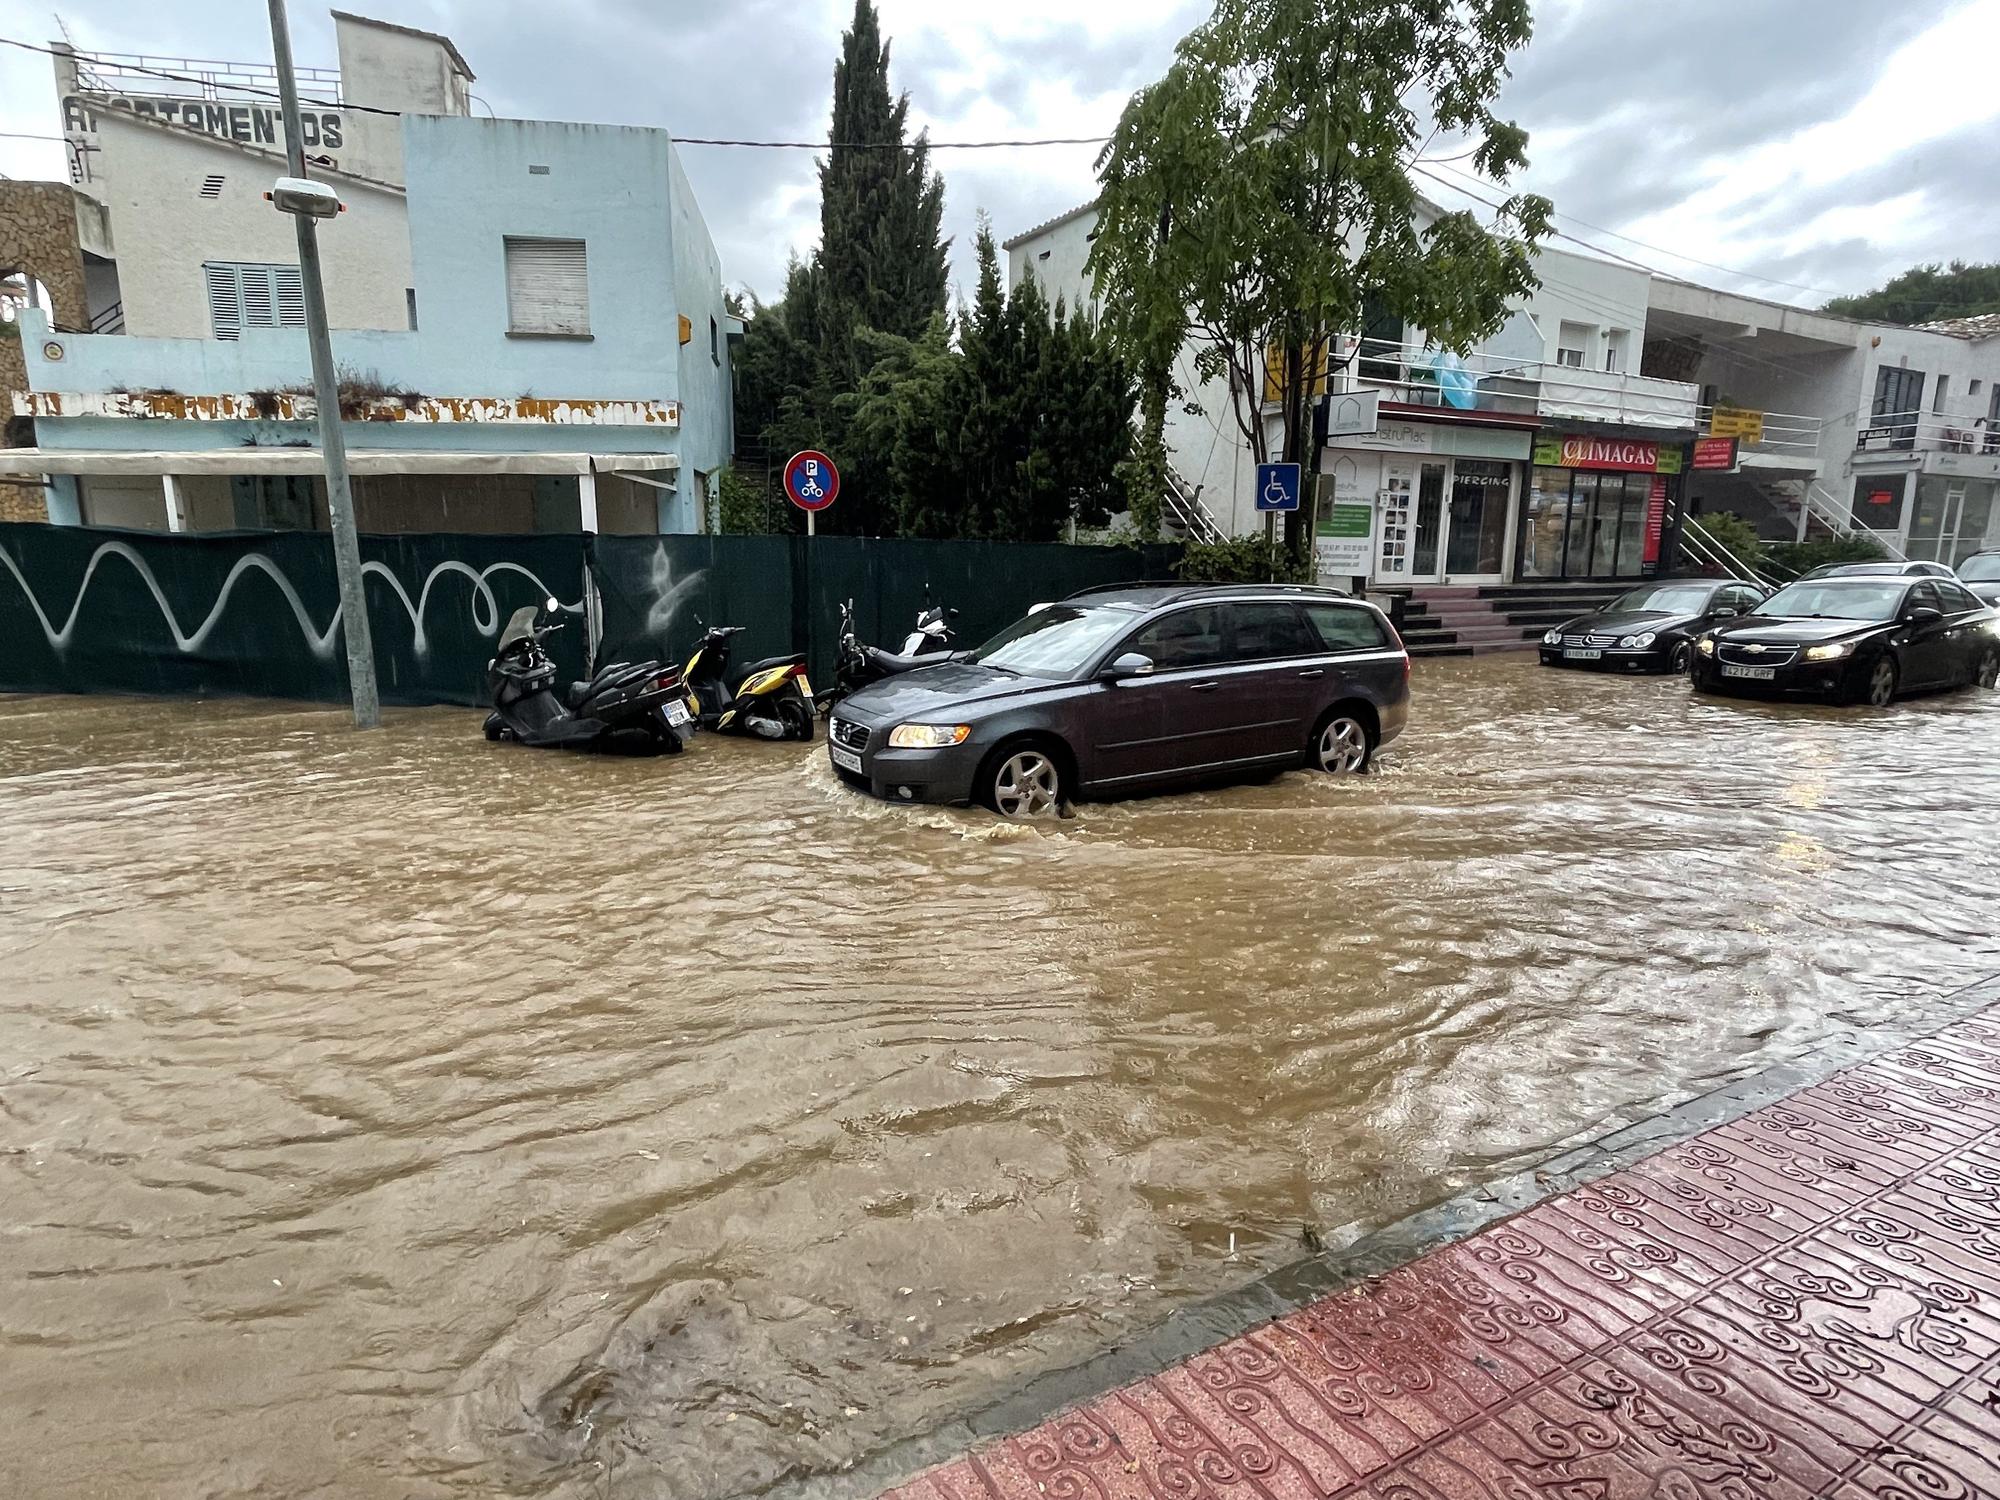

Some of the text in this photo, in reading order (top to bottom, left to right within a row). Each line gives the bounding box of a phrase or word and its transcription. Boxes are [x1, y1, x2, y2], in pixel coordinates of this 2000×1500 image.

[63, 96, 344, 149] ATAMENOS
[1563, 440, 1656, 465] CLIMAGAS
[807, 461, 816, 474] P
[1453, 474, 1509, 487] PIERCING
